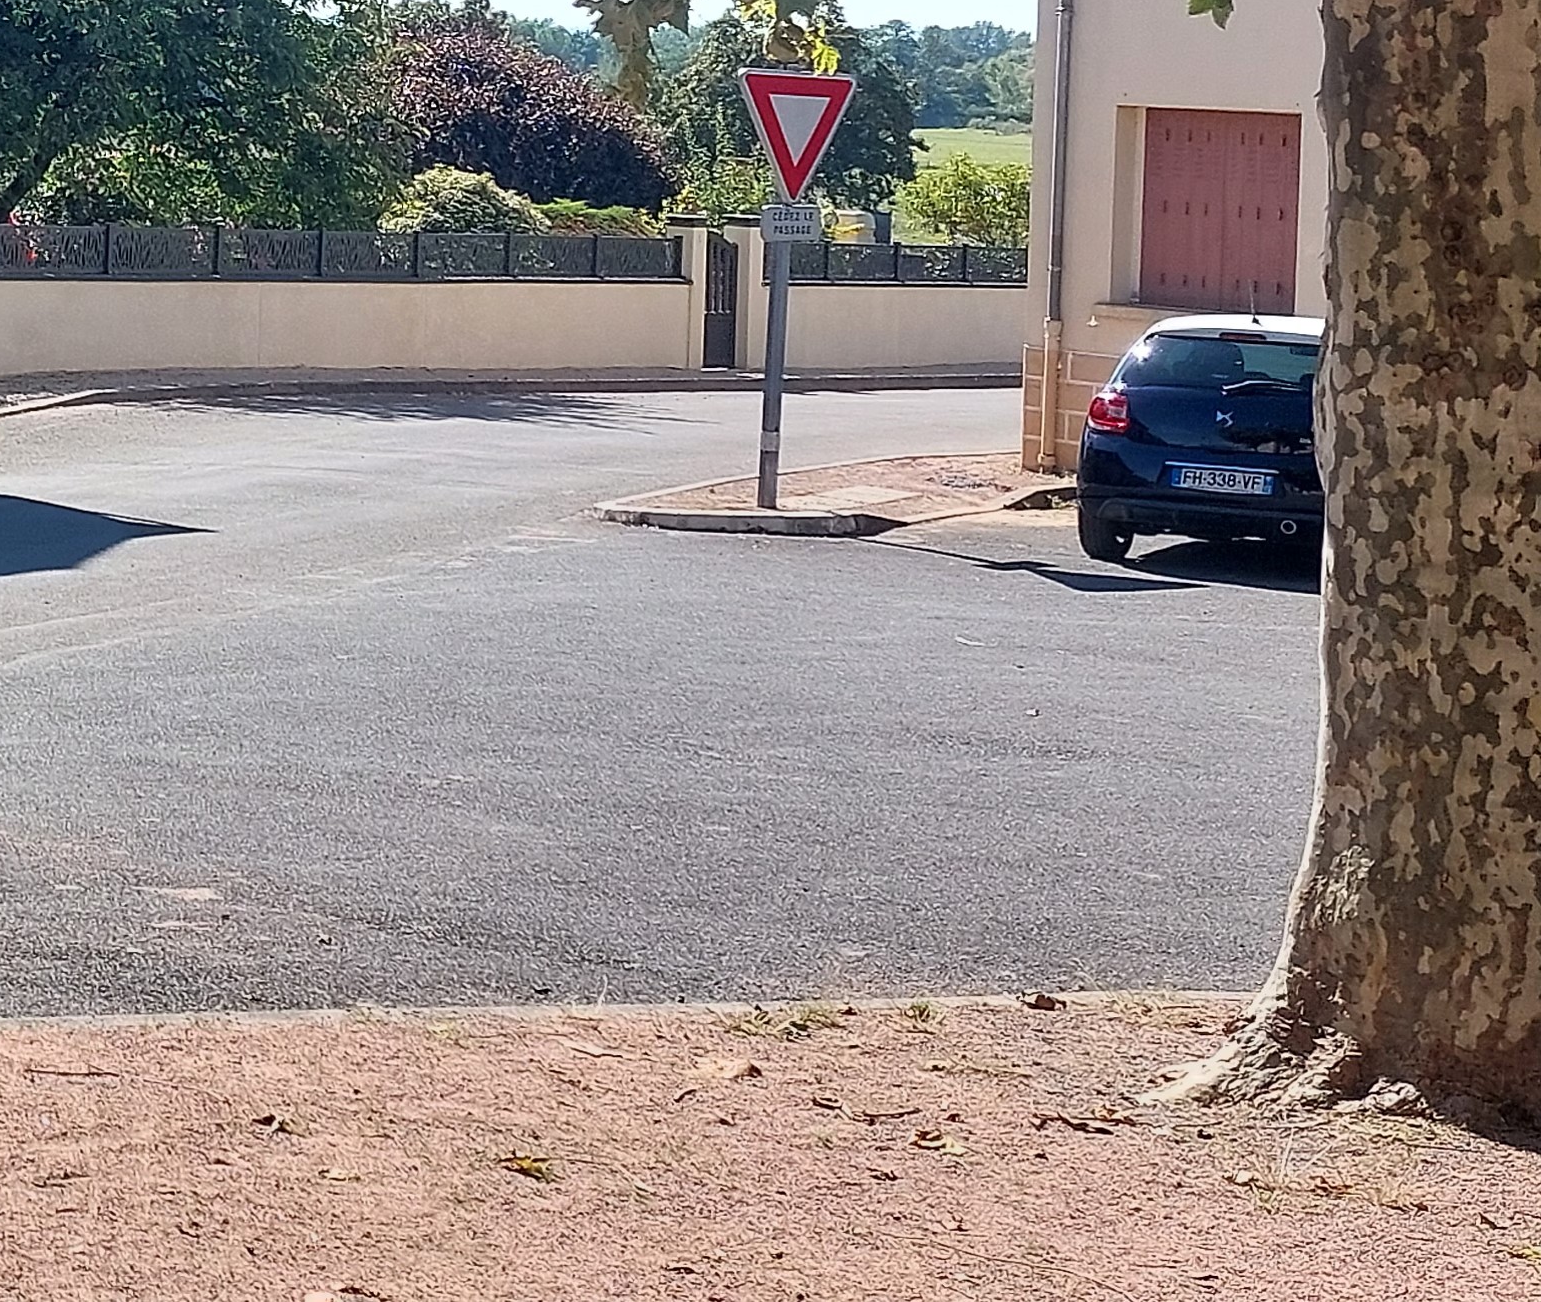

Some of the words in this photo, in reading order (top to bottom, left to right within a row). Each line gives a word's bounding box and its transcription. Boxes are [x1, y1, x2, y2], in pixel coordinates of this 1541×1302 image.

[803, 211, 815, 222] LE
[773, 225, 812, 235] PASSAGE
[1181, 469, 1263, 490] FH-338-VF
